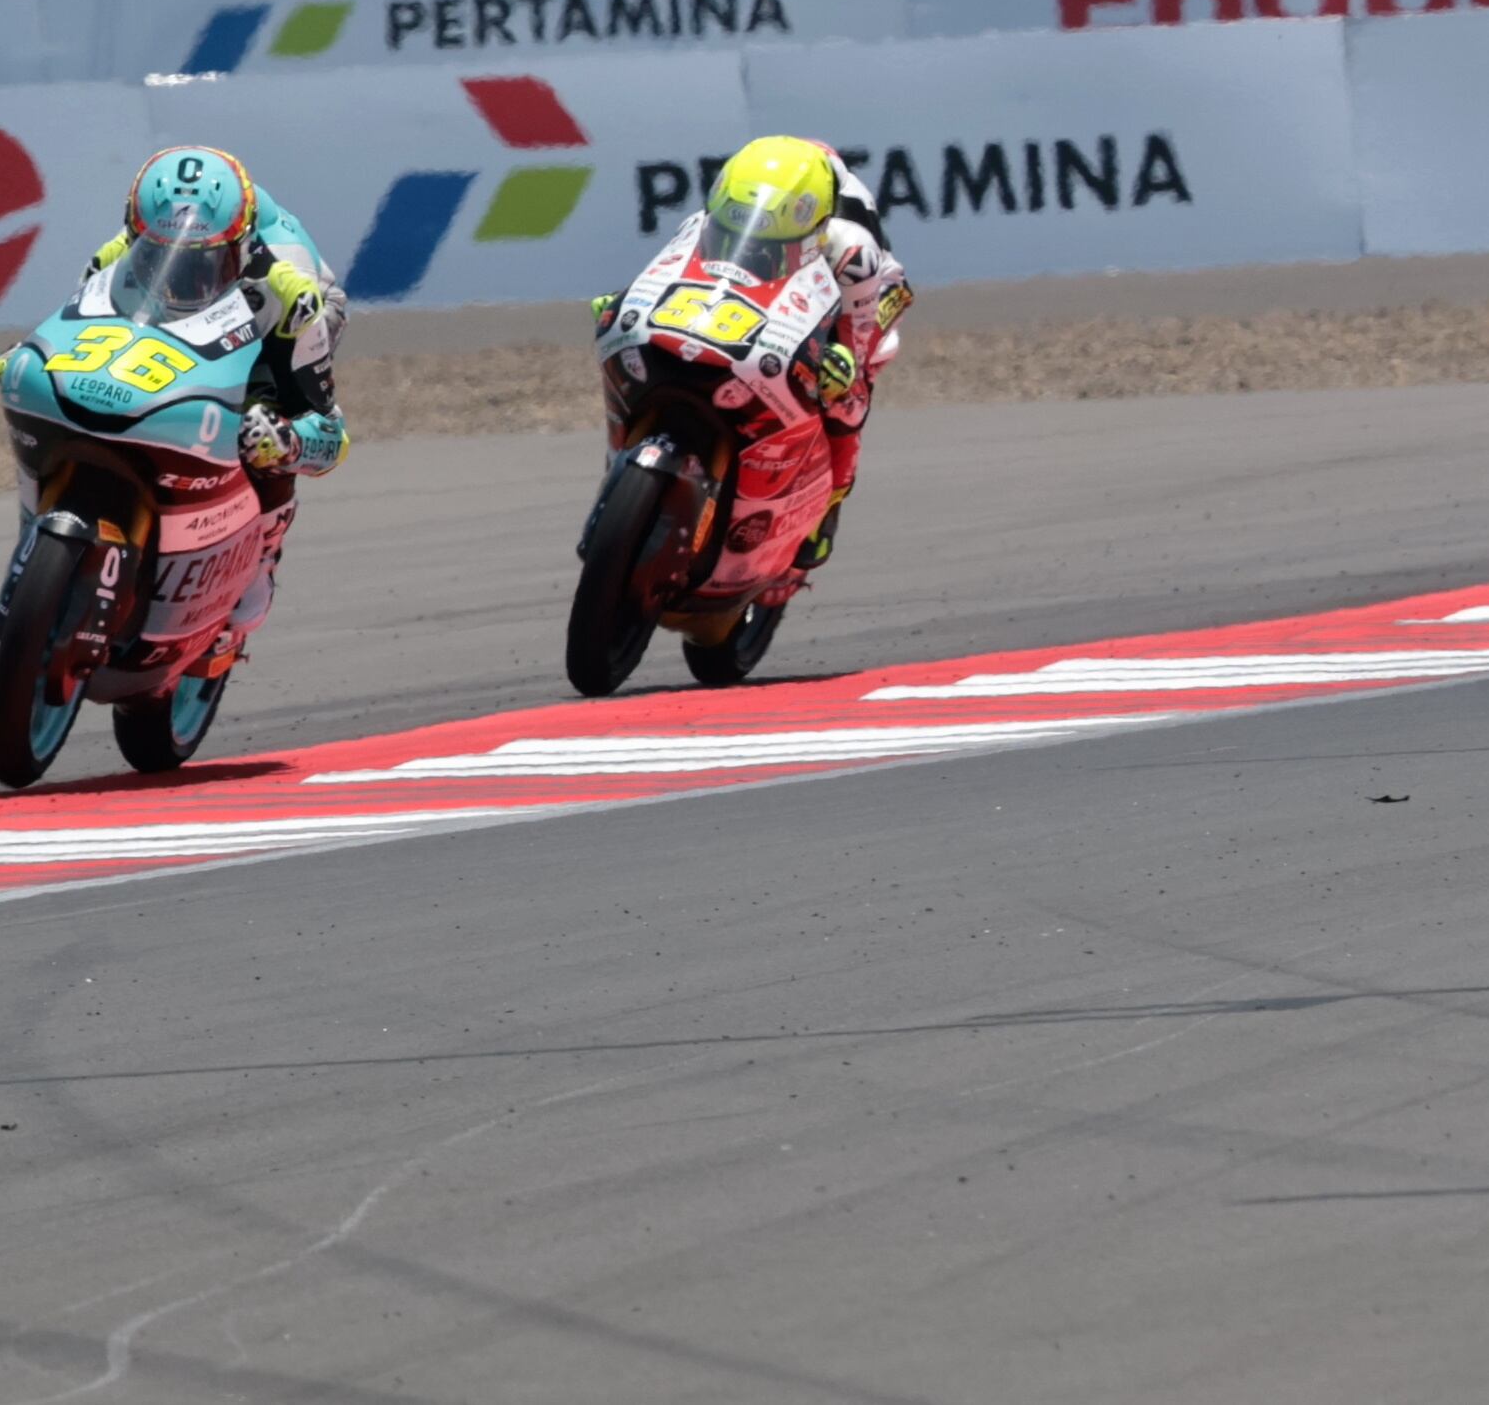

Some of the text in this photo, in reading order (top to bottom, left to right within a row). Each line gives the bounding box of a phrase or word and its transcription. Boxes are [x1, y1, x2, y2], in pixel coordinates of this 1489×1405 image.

[637, 131, 1193, 237] PAMINA
[157, 219, 210, 232] SHRK
[650, 285, 766, 346] 58
[44, 325, 198, 394] 36
[150, 524, 262, 604] LEOPARD
